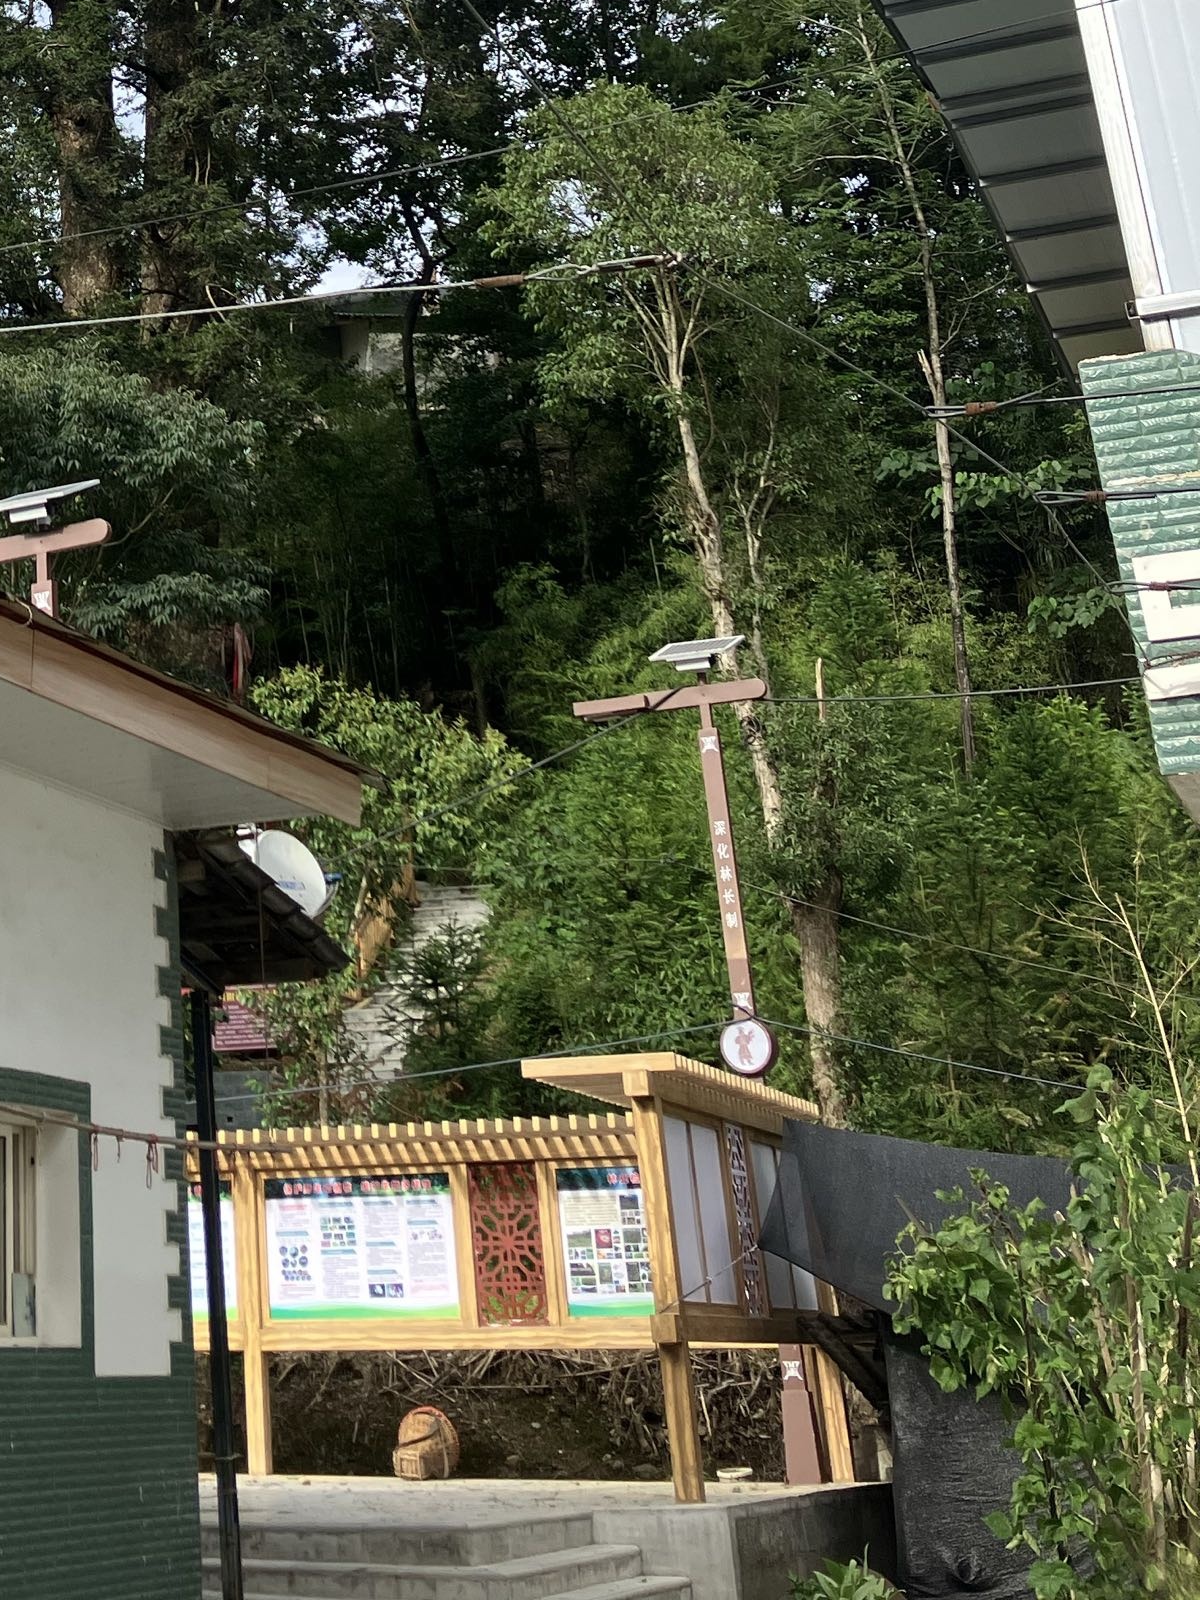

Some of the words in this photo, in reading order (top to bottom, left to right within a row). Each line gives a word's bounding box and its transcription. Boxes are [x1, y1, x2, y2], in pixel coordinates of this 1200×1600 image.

[713, 820, 738, 929] 深化林长制
